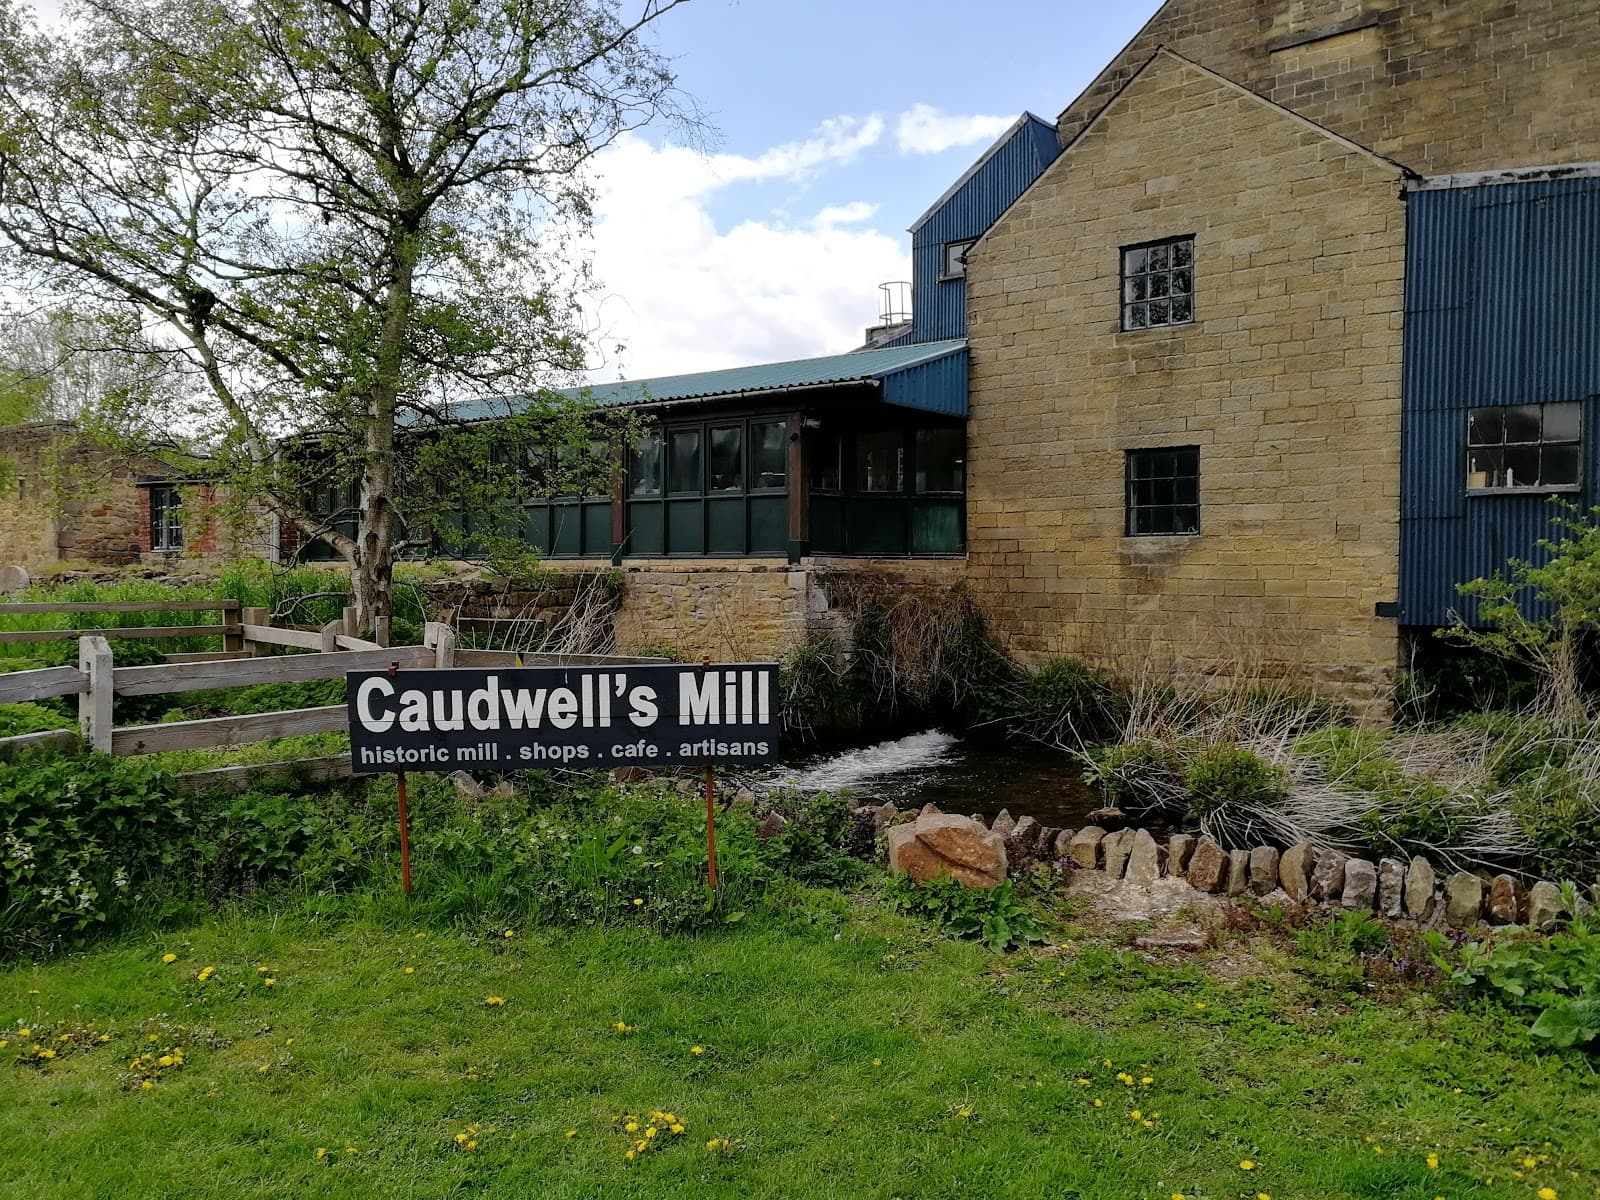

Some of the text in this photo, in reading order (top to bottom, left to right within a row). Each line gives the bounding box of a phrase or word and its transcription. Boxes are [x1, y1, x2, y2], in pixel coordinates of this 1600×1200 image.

[678, 670, 770, 726] Mill
[360, 744, 450, 764] historic
[456, 742, 498, 762] mill
[519, 742, 590, 763] shops
[611, 738, 659, 758] cafe
[679, 738, 769, 757] artisans
